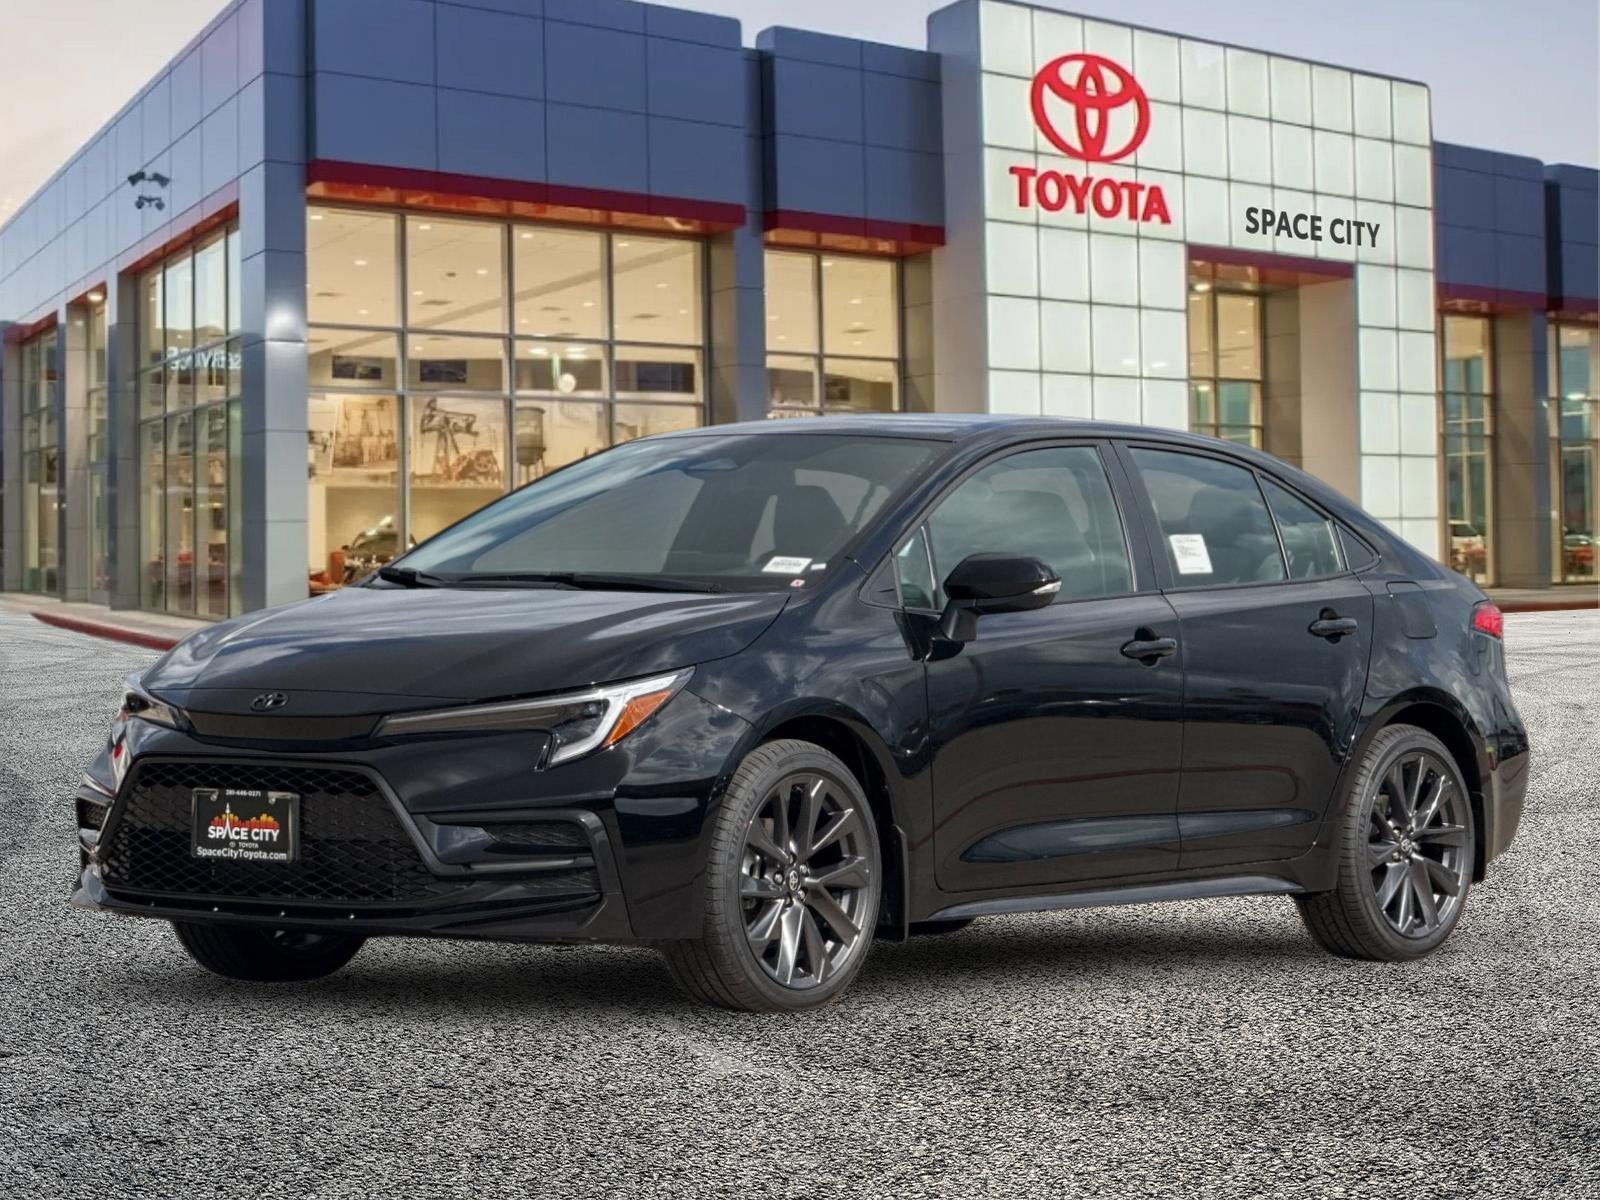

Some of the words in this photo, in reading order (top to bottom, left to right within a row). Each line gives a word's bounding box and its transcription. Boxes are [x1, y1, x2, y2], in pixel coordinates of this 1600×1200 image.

[1009, 166, 1171, 224] TOYOTA
[1245, 206, 1322, 242] SPACE
[1330, 217, 1381, 248] CITY
[208, 825, 248, 840] SPACE
[251, 828, 280, 841] CITY
[197, 847, 287, 860] SpaceCityToyota.com
